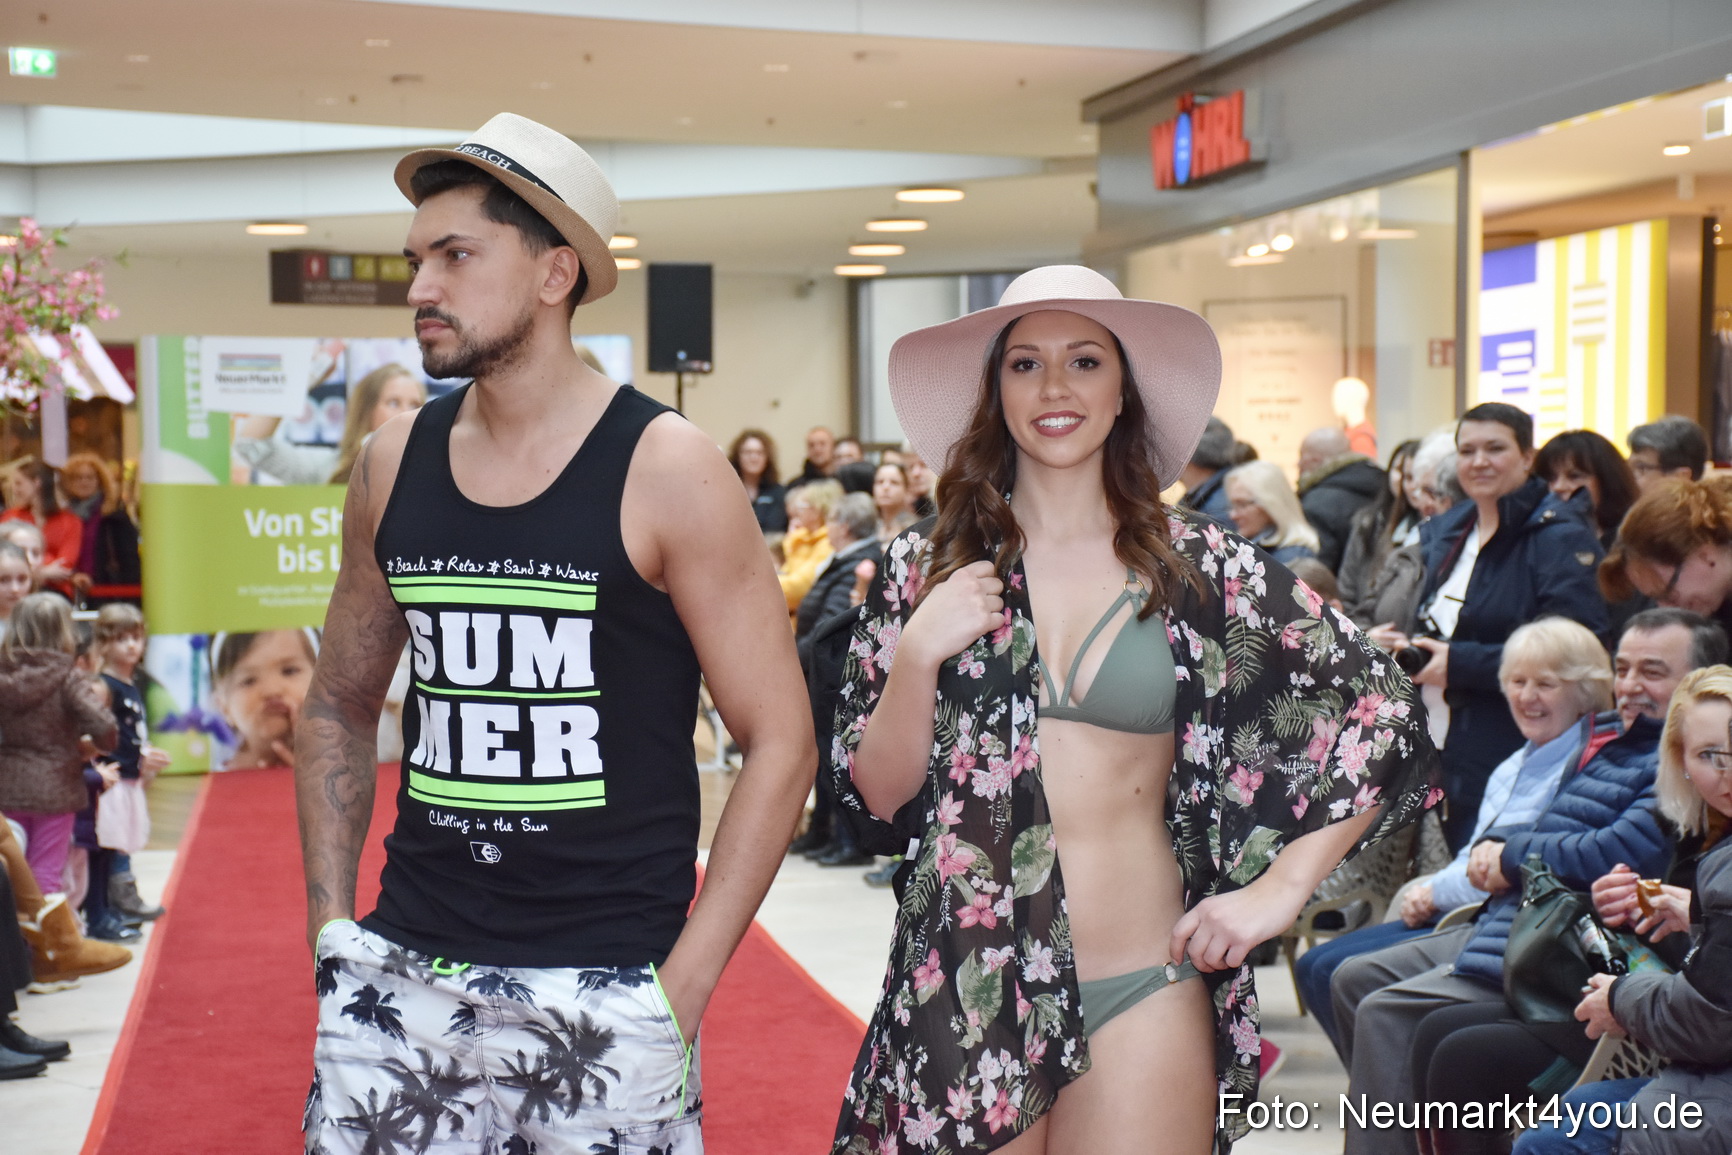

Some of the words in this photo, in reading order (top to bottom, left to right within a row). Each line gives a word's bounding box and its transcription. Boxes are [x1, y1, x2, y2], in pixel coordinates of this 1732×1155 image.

[461, 145, 512, 170] BEACH
[243, 508, 305, 538] Von
[278, 543, 324, 573] bis
[404, 609, 595, 689] SUM
[409, 694, 603, 778] MER
[428, 809, 470, 834] Chilling
[476, 818, 487, 831] in
[493, 816, 514, 832] the
[520, 817, 549, 832] Sun
